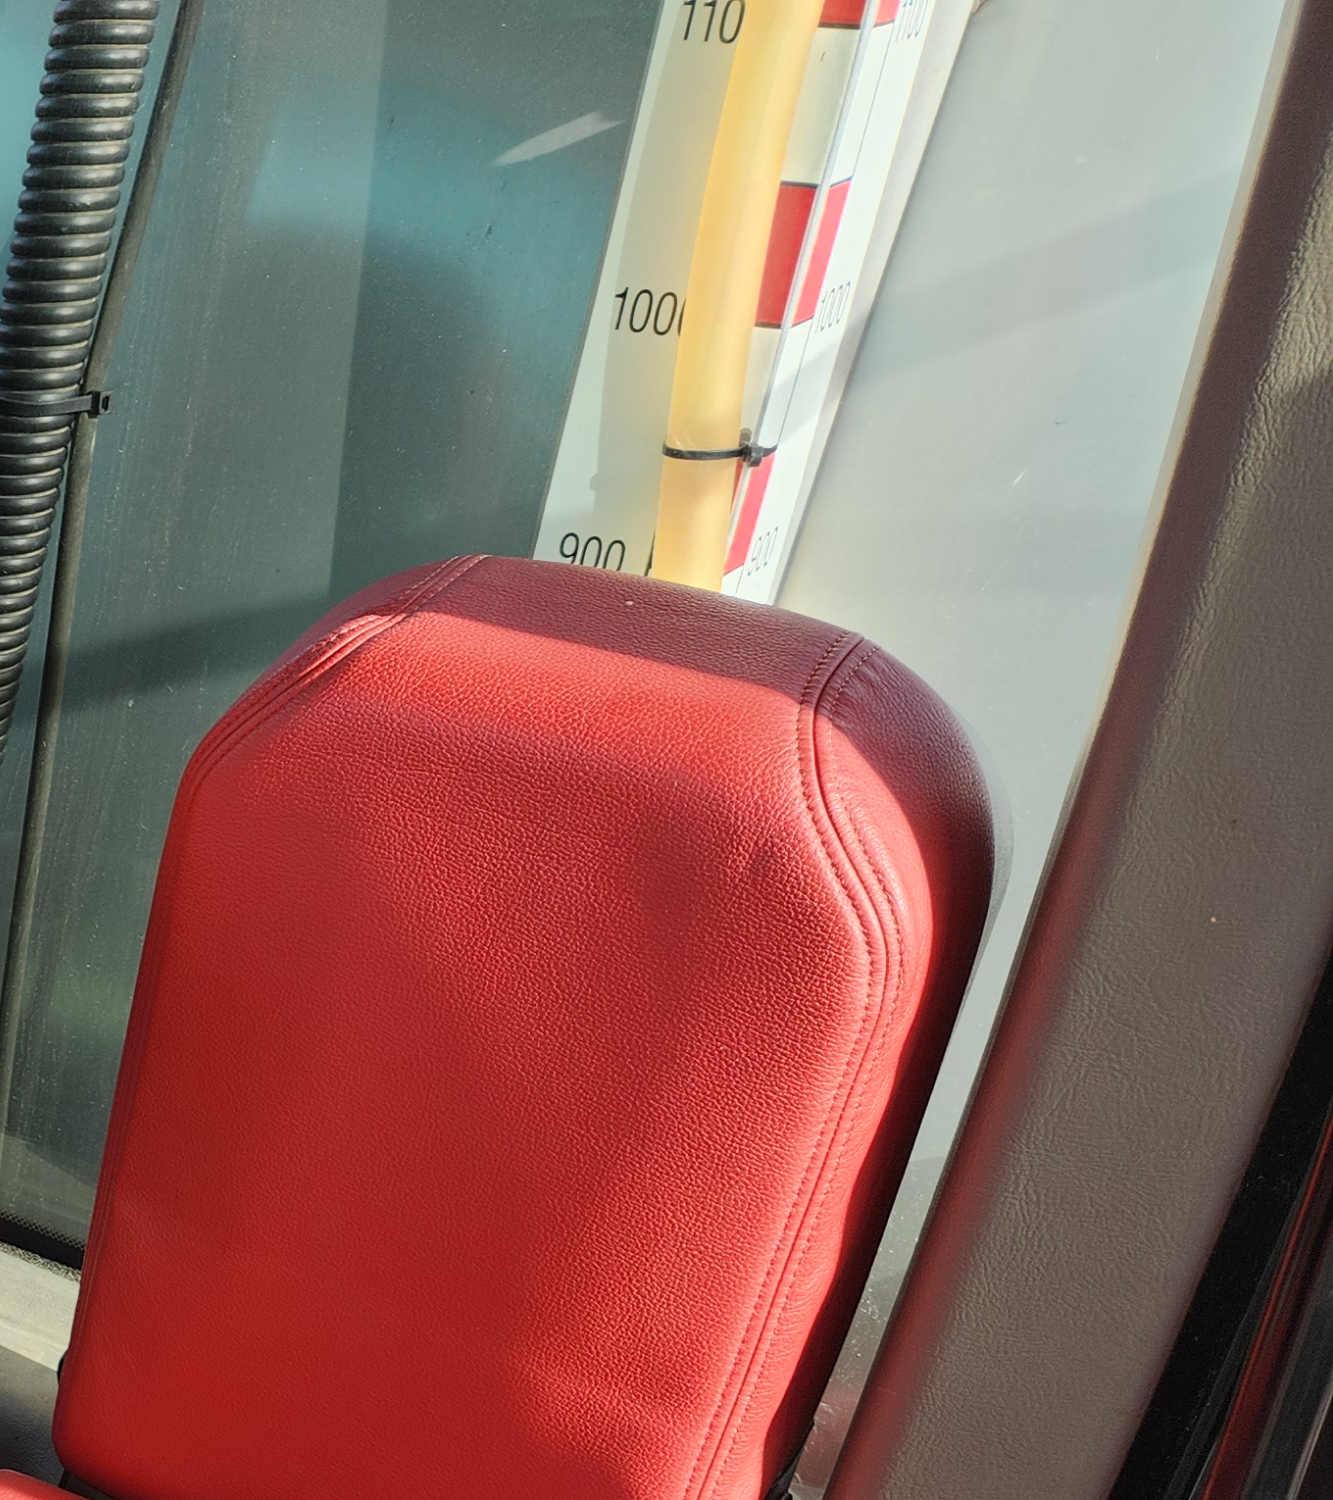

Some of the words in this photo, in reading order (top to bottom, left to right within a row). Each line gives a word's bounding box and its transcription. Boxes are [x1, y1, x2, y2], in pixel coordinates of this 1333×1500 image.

[683, 0, 746, 44] 110
[814, 280, 851, 334] 1000
[747, 526, 779, 576] 900
